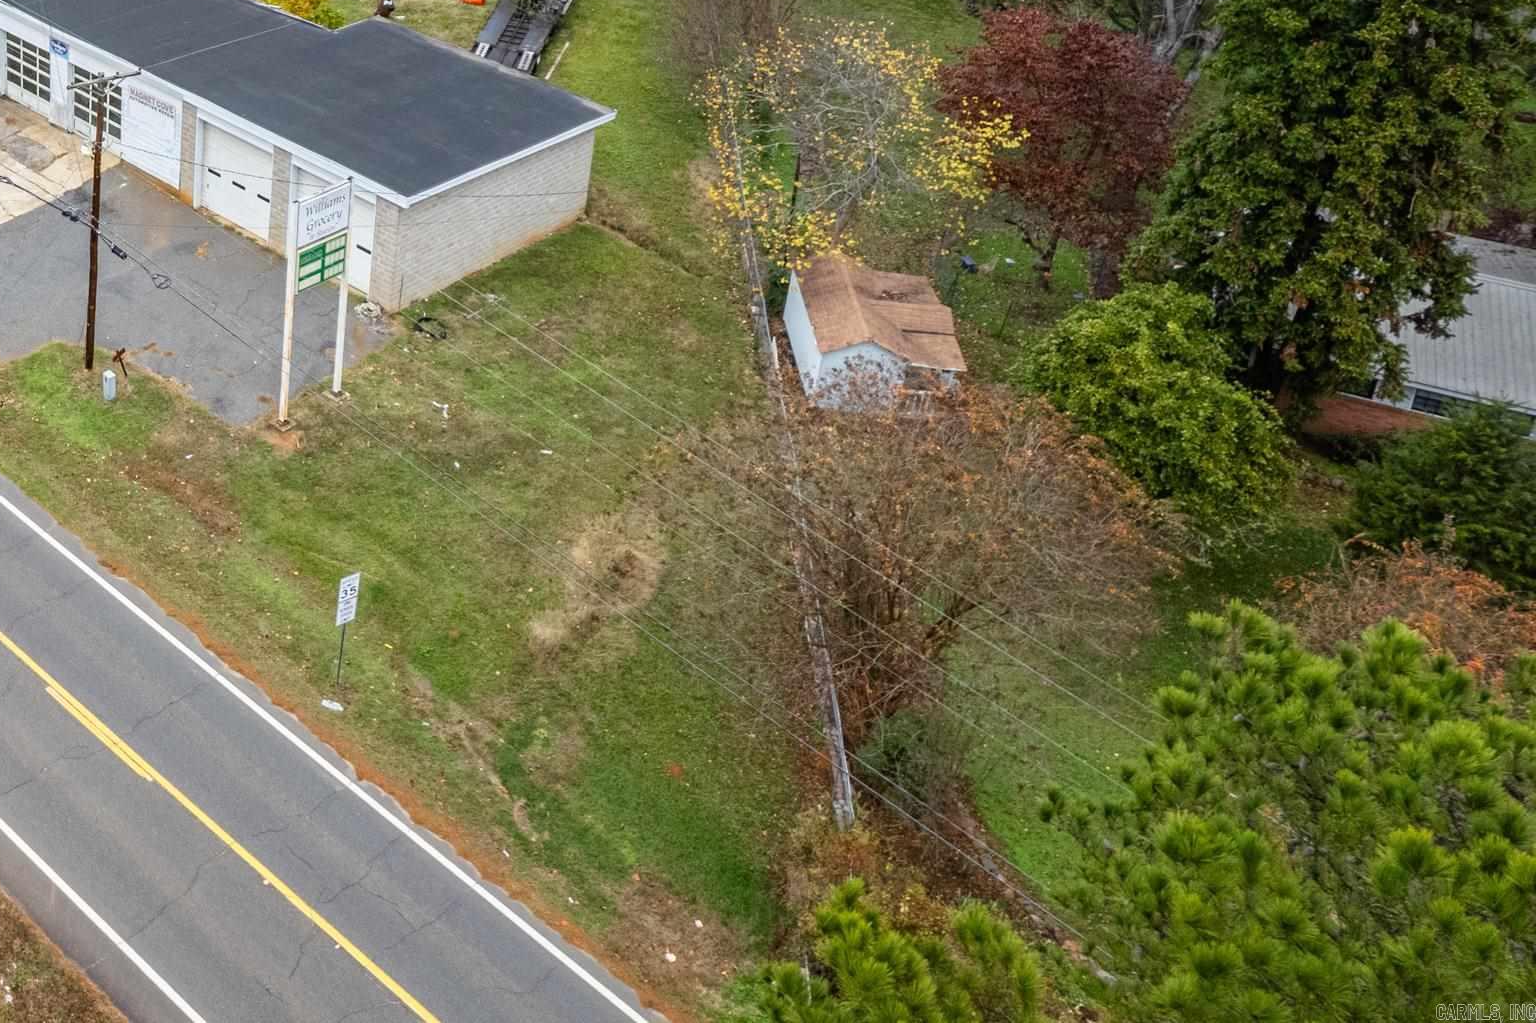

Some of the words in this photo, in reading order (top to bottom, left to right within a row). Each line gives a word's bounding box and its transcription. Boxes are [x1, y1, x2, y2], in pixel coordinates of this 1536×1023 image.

[305, 195, 346, 217] Williams
[306, 209, 344, 232] Grocery
[341, 585, 357, 599] 35
